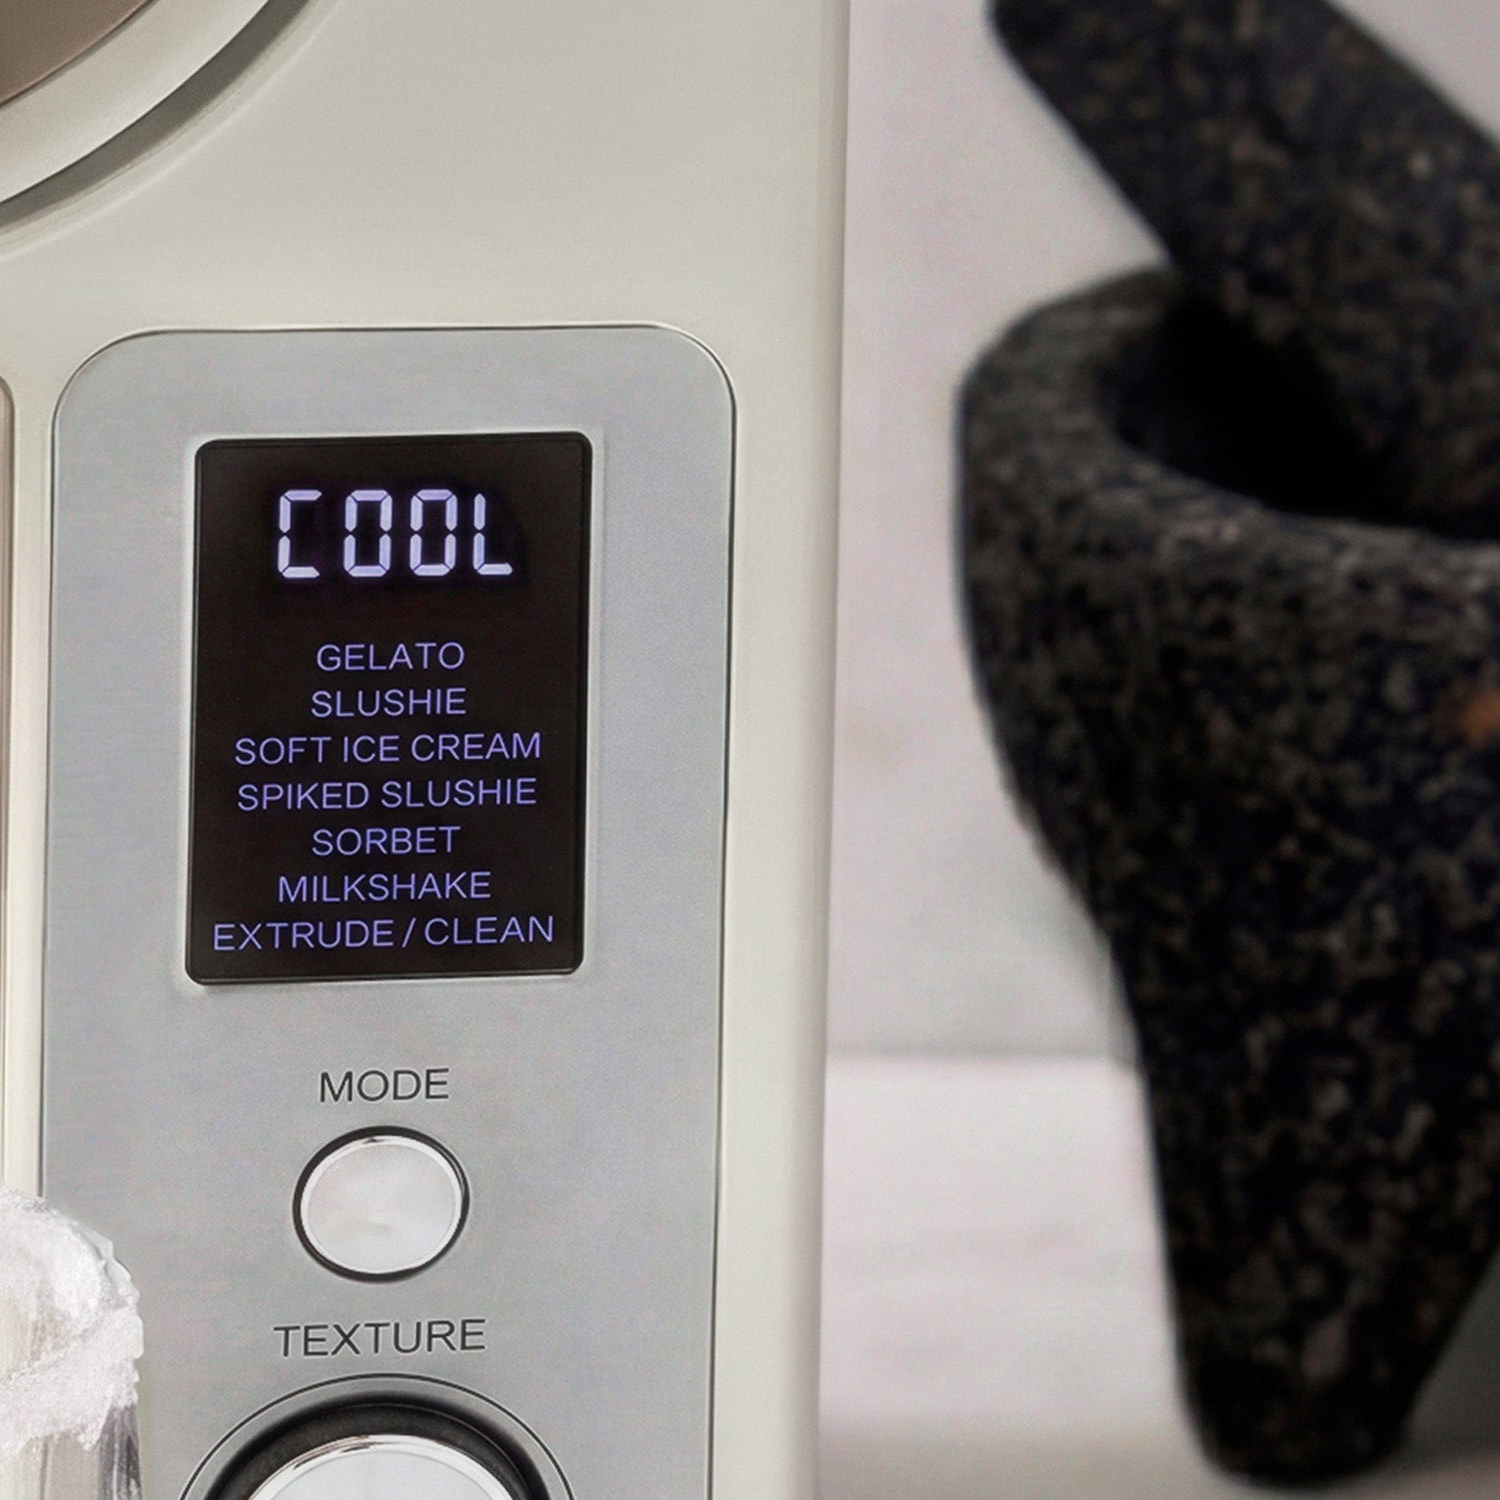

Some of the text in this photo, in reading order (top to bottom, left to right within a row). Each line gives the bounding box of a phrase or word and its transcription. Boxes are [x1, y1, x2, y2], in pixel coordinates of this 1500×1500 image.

[277, 488, 513, 578] COOL
[316, 641, 465, 671] GELATO
[311, 687, 466, 718] SLUSHIE
[235, 732, 540, 765] SOFT ICE CREAM
[238, 777, 536, 811] SPIKED SLUSHIE
[312, 826, 461, 856] SORBET
[279, 871, 491, 903] MILKSHAKE
[213, 919, 394, 951] EXTRUDE
[424, 915, 553, 945] CLEAN
[320, 1068, 449, 1103] MODE
[273, 1318, 486, 1357] TEXTURE
